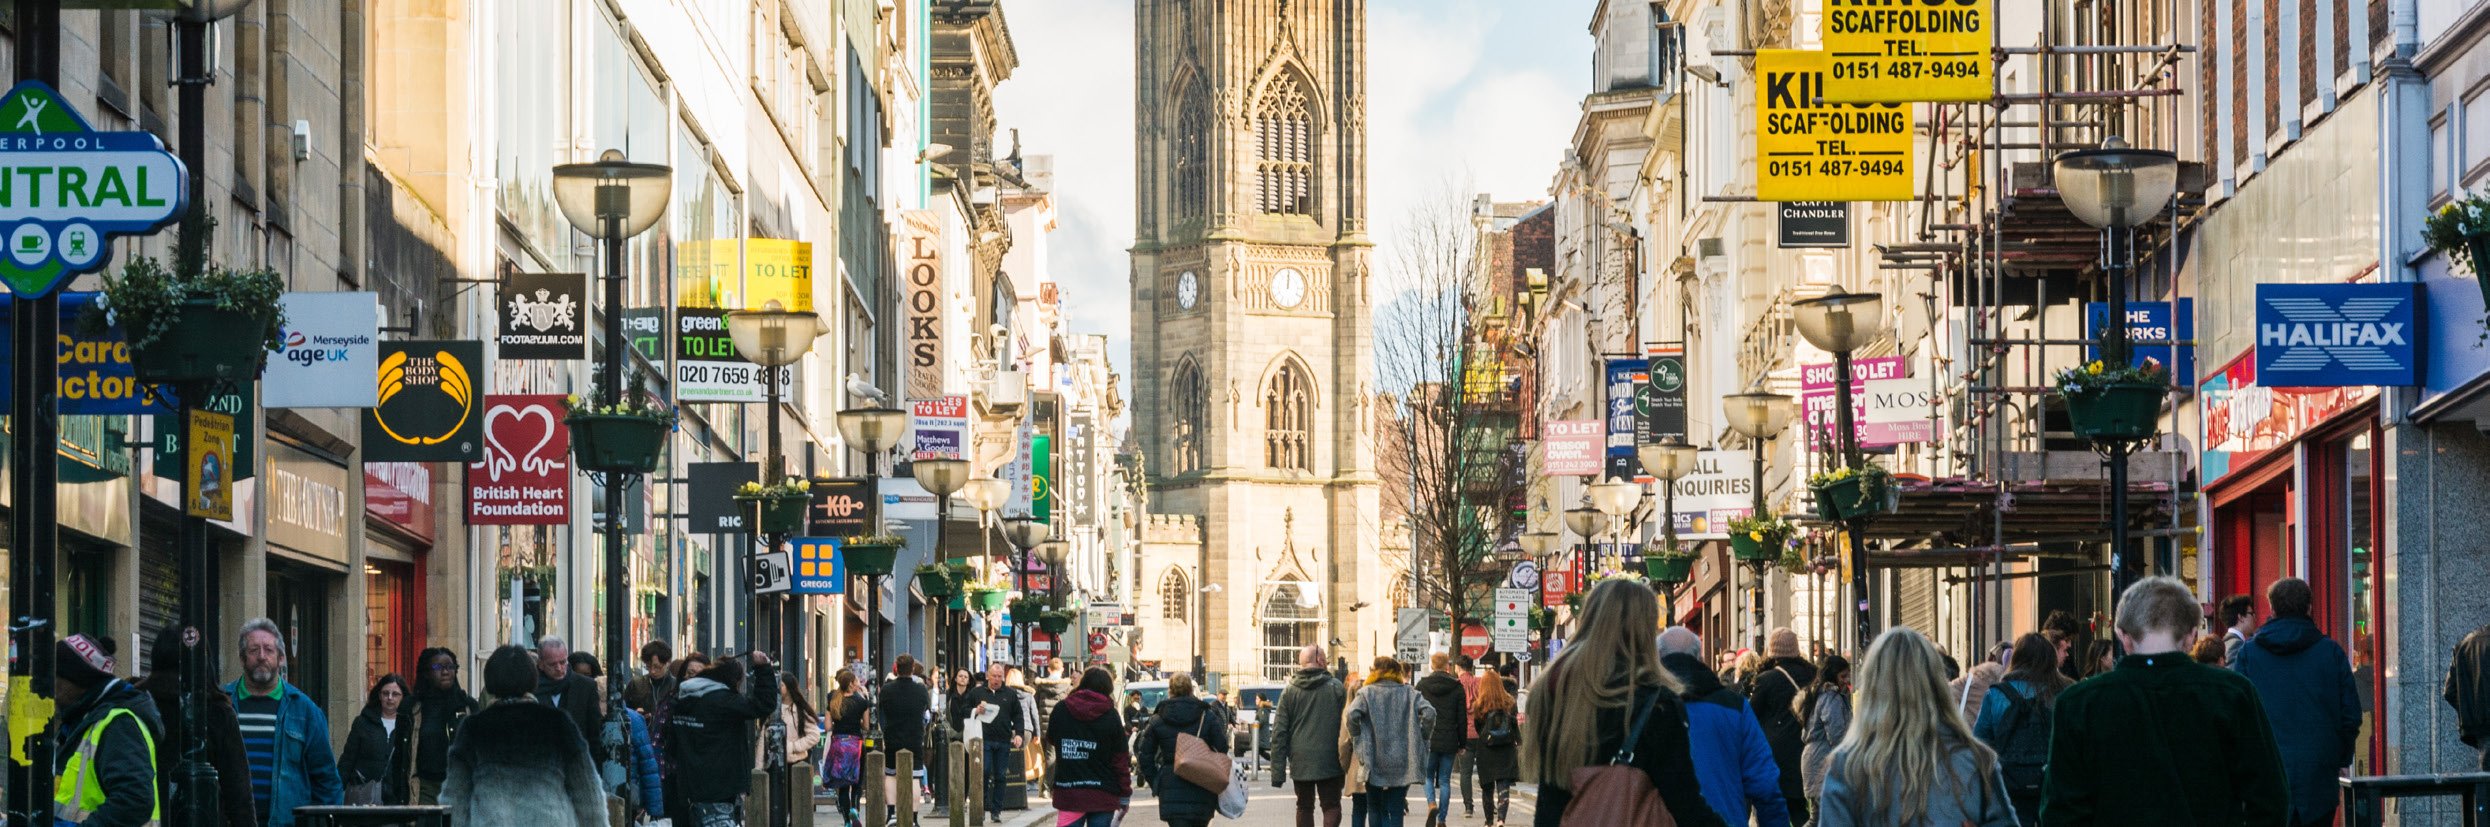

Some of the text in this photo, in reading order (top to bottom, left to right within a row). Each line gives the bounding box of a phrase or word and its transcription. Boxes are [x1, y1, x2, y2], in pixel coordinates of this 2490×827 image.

[1831, 10, 1979, 33] SCAFFOLDING
[1884, 40, 1927, 56] TEL.
[1833, 61, 1979, 79] 0151 487-9494
[1816, 140, 1856, 156] TEL.
[1769, 160, 1904, 176] 0151 487-9494
[755, 264, 810, 279] TO LET
[910, 237, 939, 367] LOOKS
[2125, 310, 2151, 323] HE
[313, 335, 370, 347] Merseyside
[2262, 322, 2407, 346] HALIFAX
[682, 337, 735, 357] TO LET
[287, 349, 348, 367] age UK
[408, 357, 435, 366] THE
[405, 366, 436, 375] BODY
[679, 366, 708, 383] 020
[711, 366, 749, 385] 7659
[1806, 366, 1835, 384] SHO
[1869, 361, 1897, 378] LET
[405, 376, 439, 385] SHOP
[917, 405, 958, 416] TO LET
[1547, 422, 1600, 435] TO LET
[1898, 431, 1921, 440] HIRE
[917, 435, 951, 444] Matthews
[1547, 441, 1590, 450] mason
[1076, 423, 1086, 500] TATTOO
[473, 486, 564, 499] British Heart
[473, 501, 564, 516] Foundation
[826, 494, 853, 517] KO
[718, 516, 744, 527] RIC
[800, 580, 833, 589] GREGGS
[1400, 652, 1425, 661] ENDS
